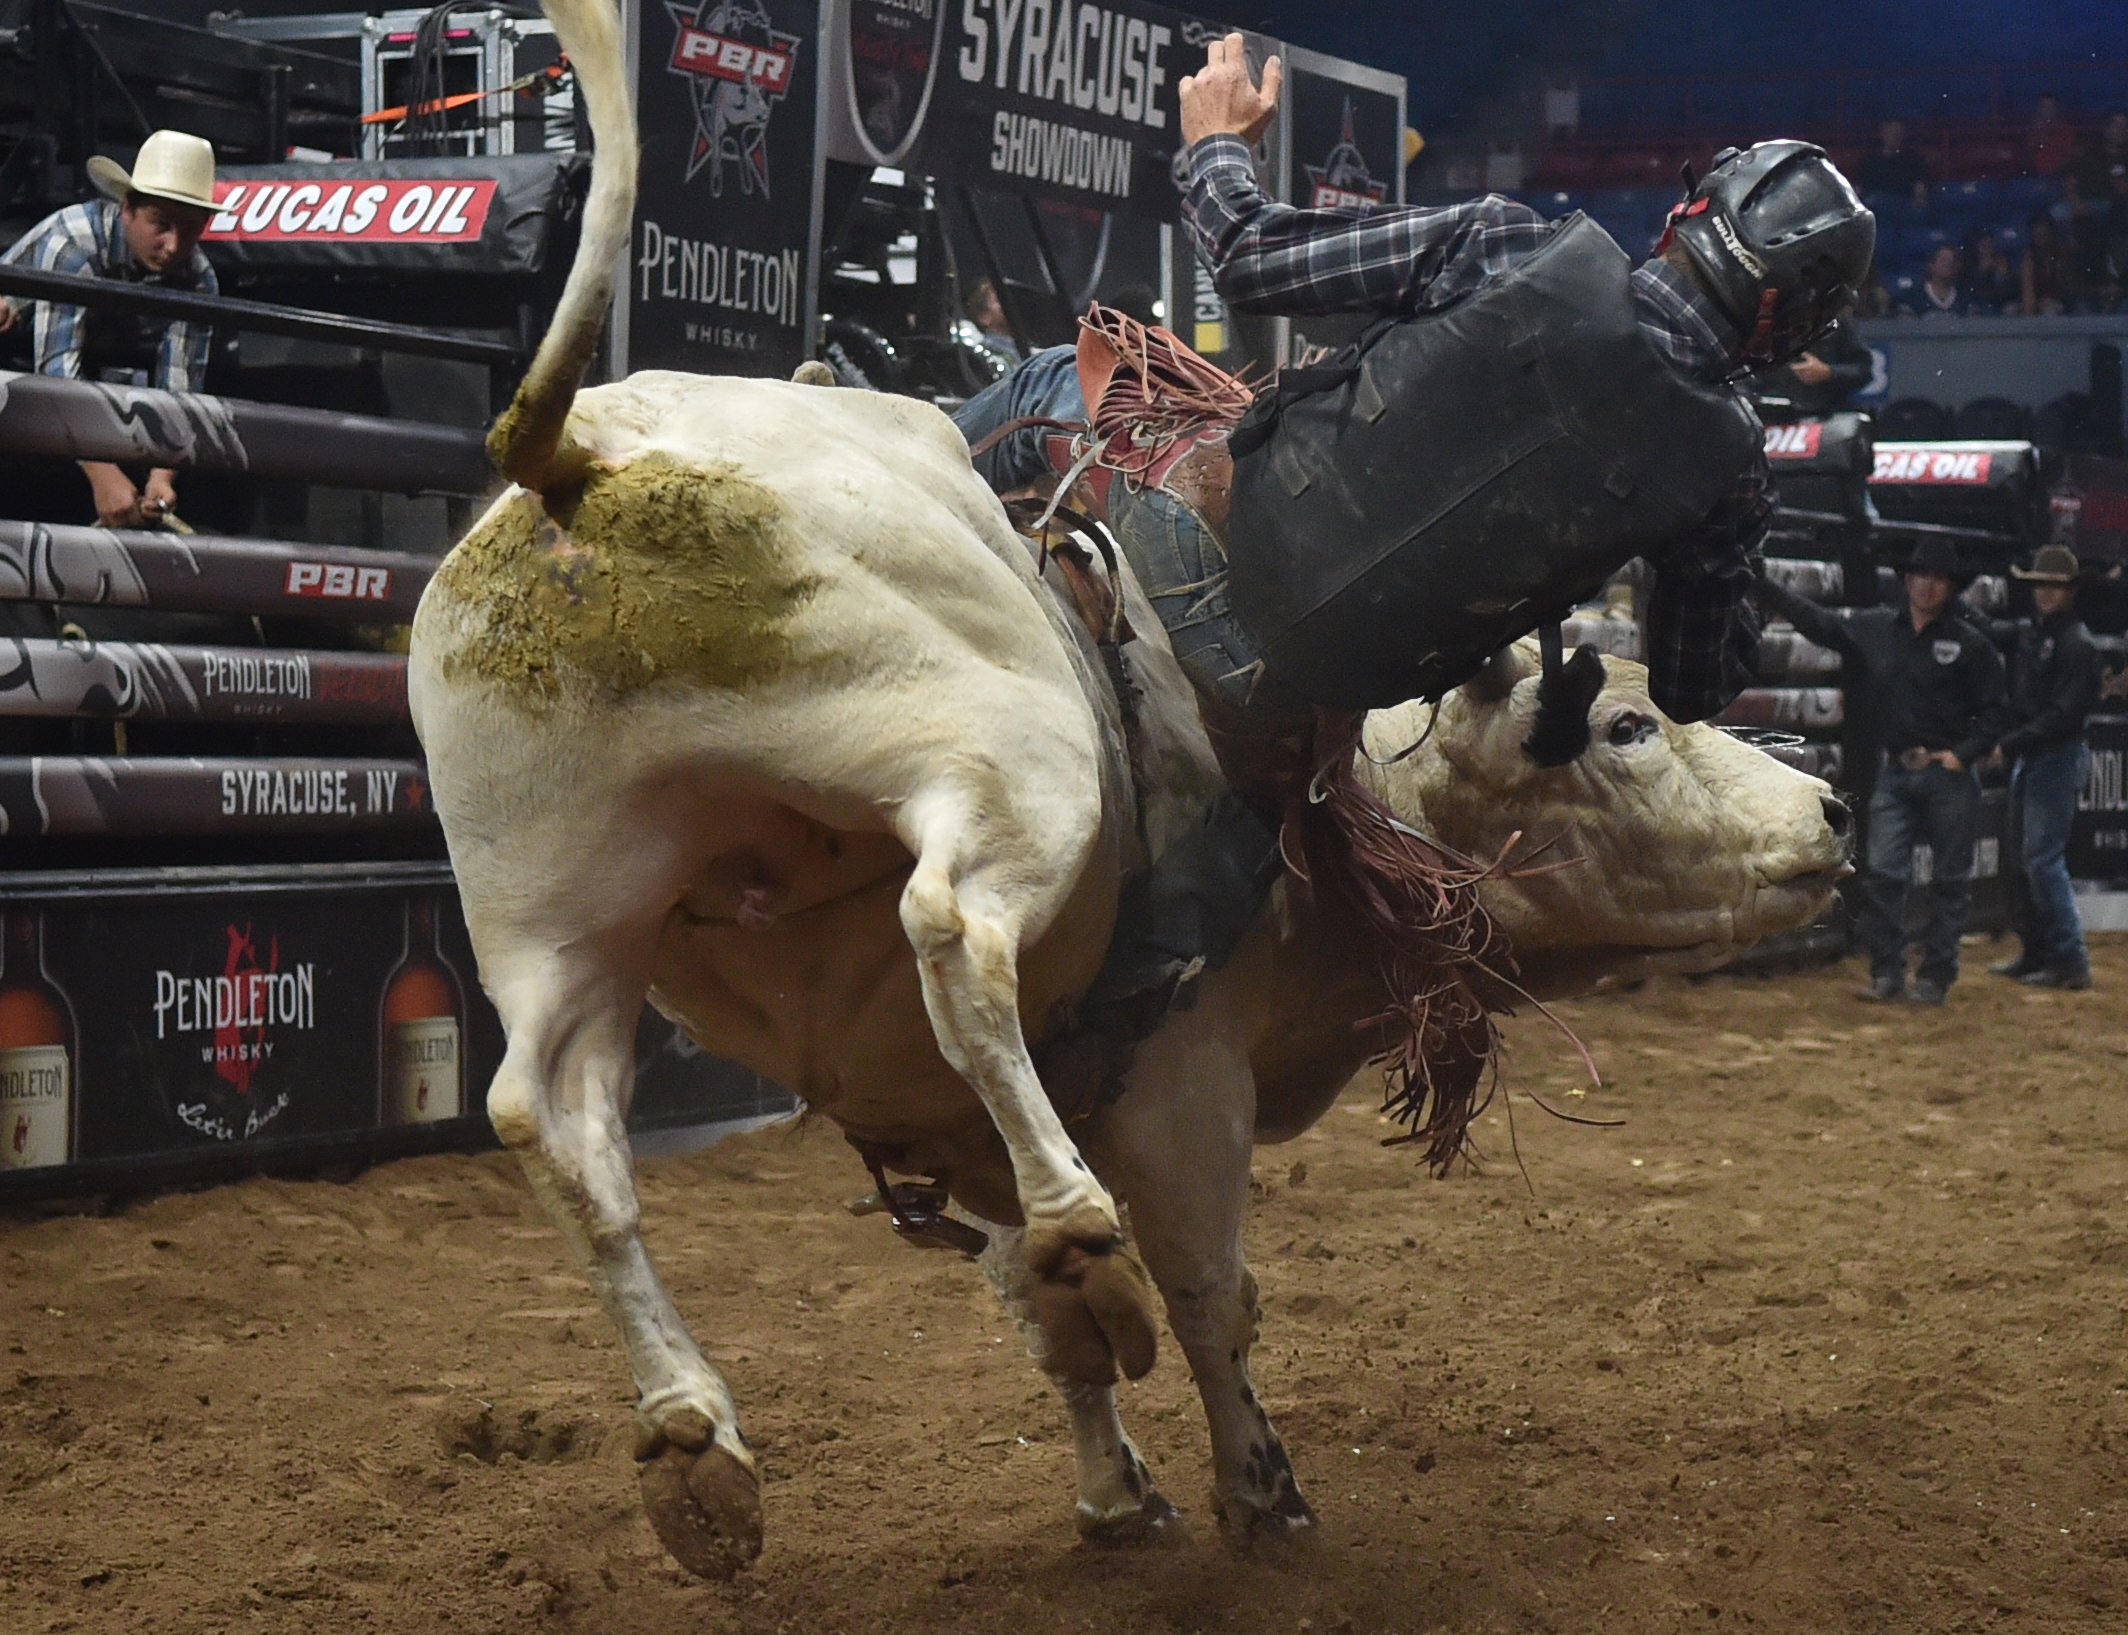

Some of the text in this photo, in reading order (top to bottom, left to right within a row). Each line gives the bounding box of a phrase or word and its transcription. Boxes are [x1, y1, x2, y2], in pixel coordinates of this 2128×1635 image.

[681, 32, 787, 82] PBR
[960, 0, 1172, 128] SYRACUSE
[991, 111, 1132, 198] SHOWDOWN
[209, 185, 476, 234] LUCAS OIL
[638, 220, 800, 327] PENDLETON
[685, 321, 758, 350] WHISKY
[1932, 454, 1980, 480] OIL
[288, 563, 389, 599] PBR
[203, 651, 311, 699] PENDLETON
[221, 770, 398, 818] SYRACUSE, NY
[153, 963, 315, 1039] PENDLETON
[202, 1042, 275, 1063] WHISKY
